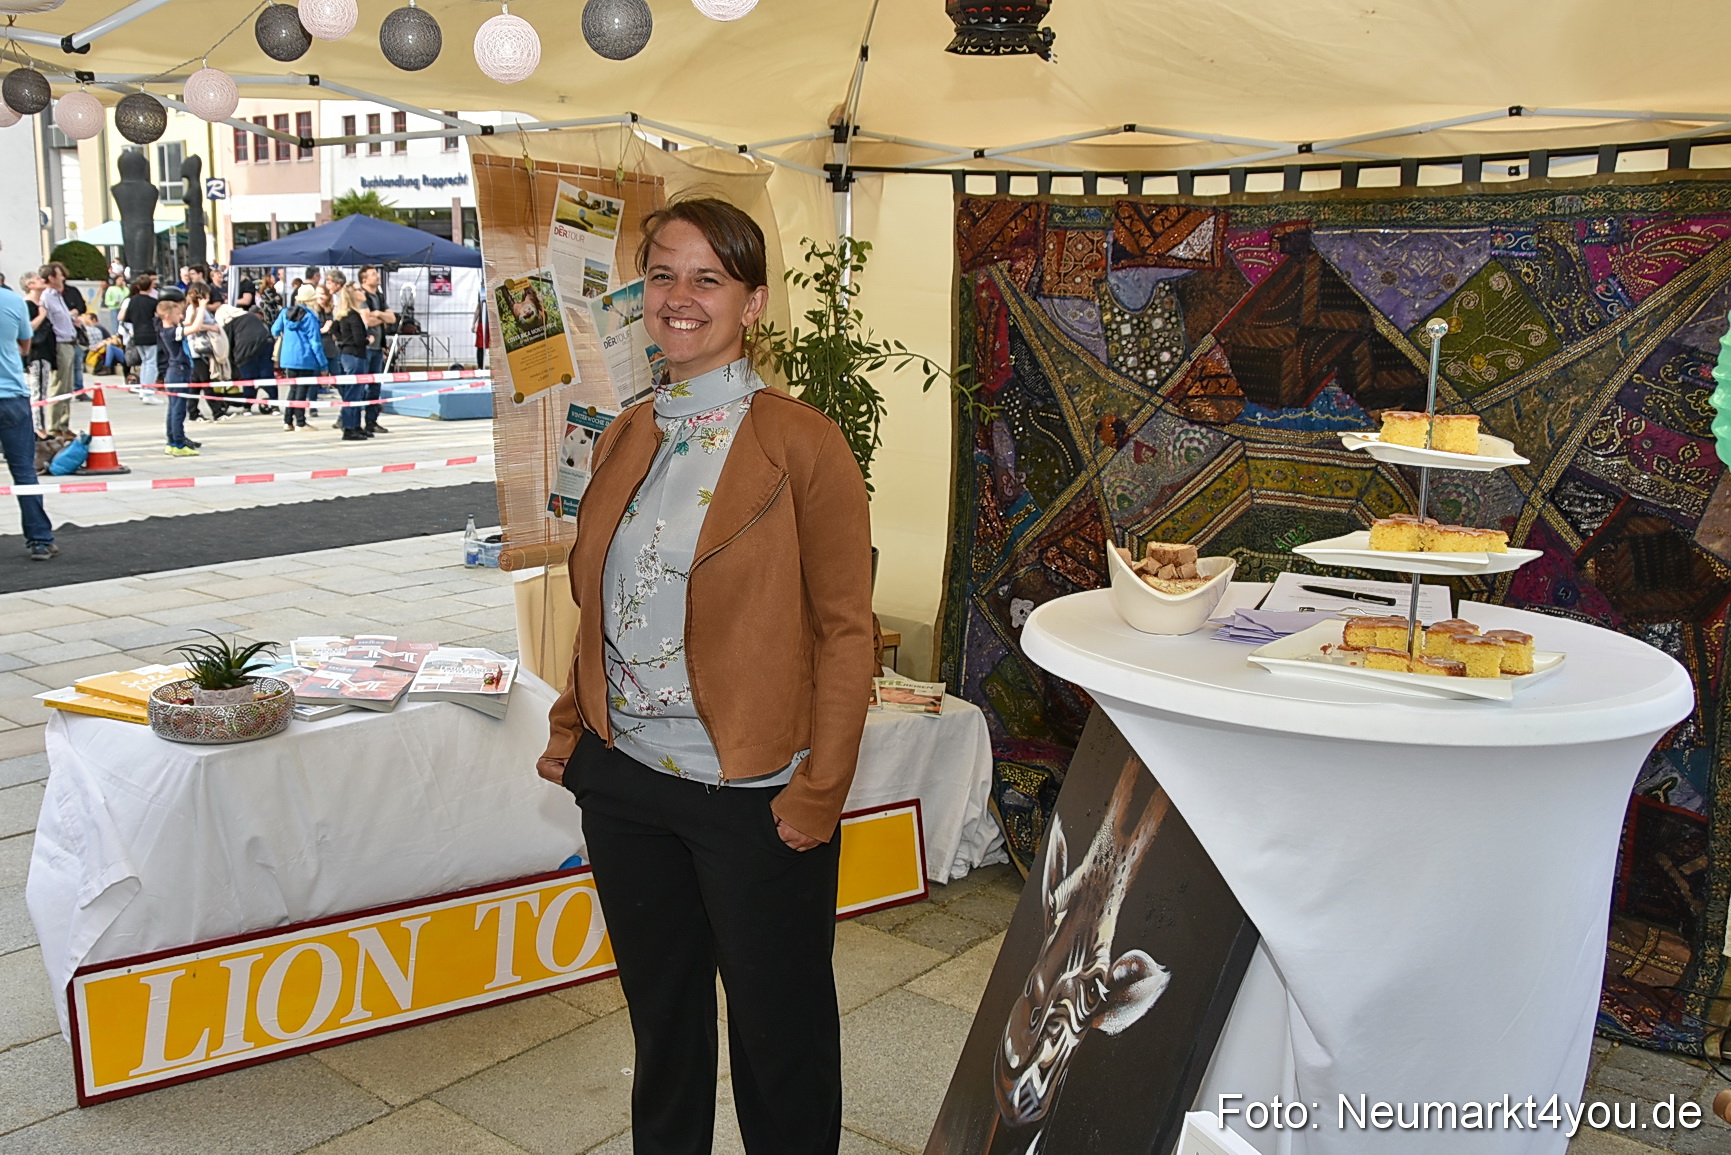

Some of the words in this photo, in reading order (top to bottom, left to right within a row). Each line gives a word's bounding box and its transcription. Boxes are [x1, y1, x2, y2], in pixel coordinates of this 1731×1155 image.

[360, 174, 420, 190] Buchhandlung
[422, 172, 468, 190] Rupprecht
[128, 916, 432, 1078] LION
